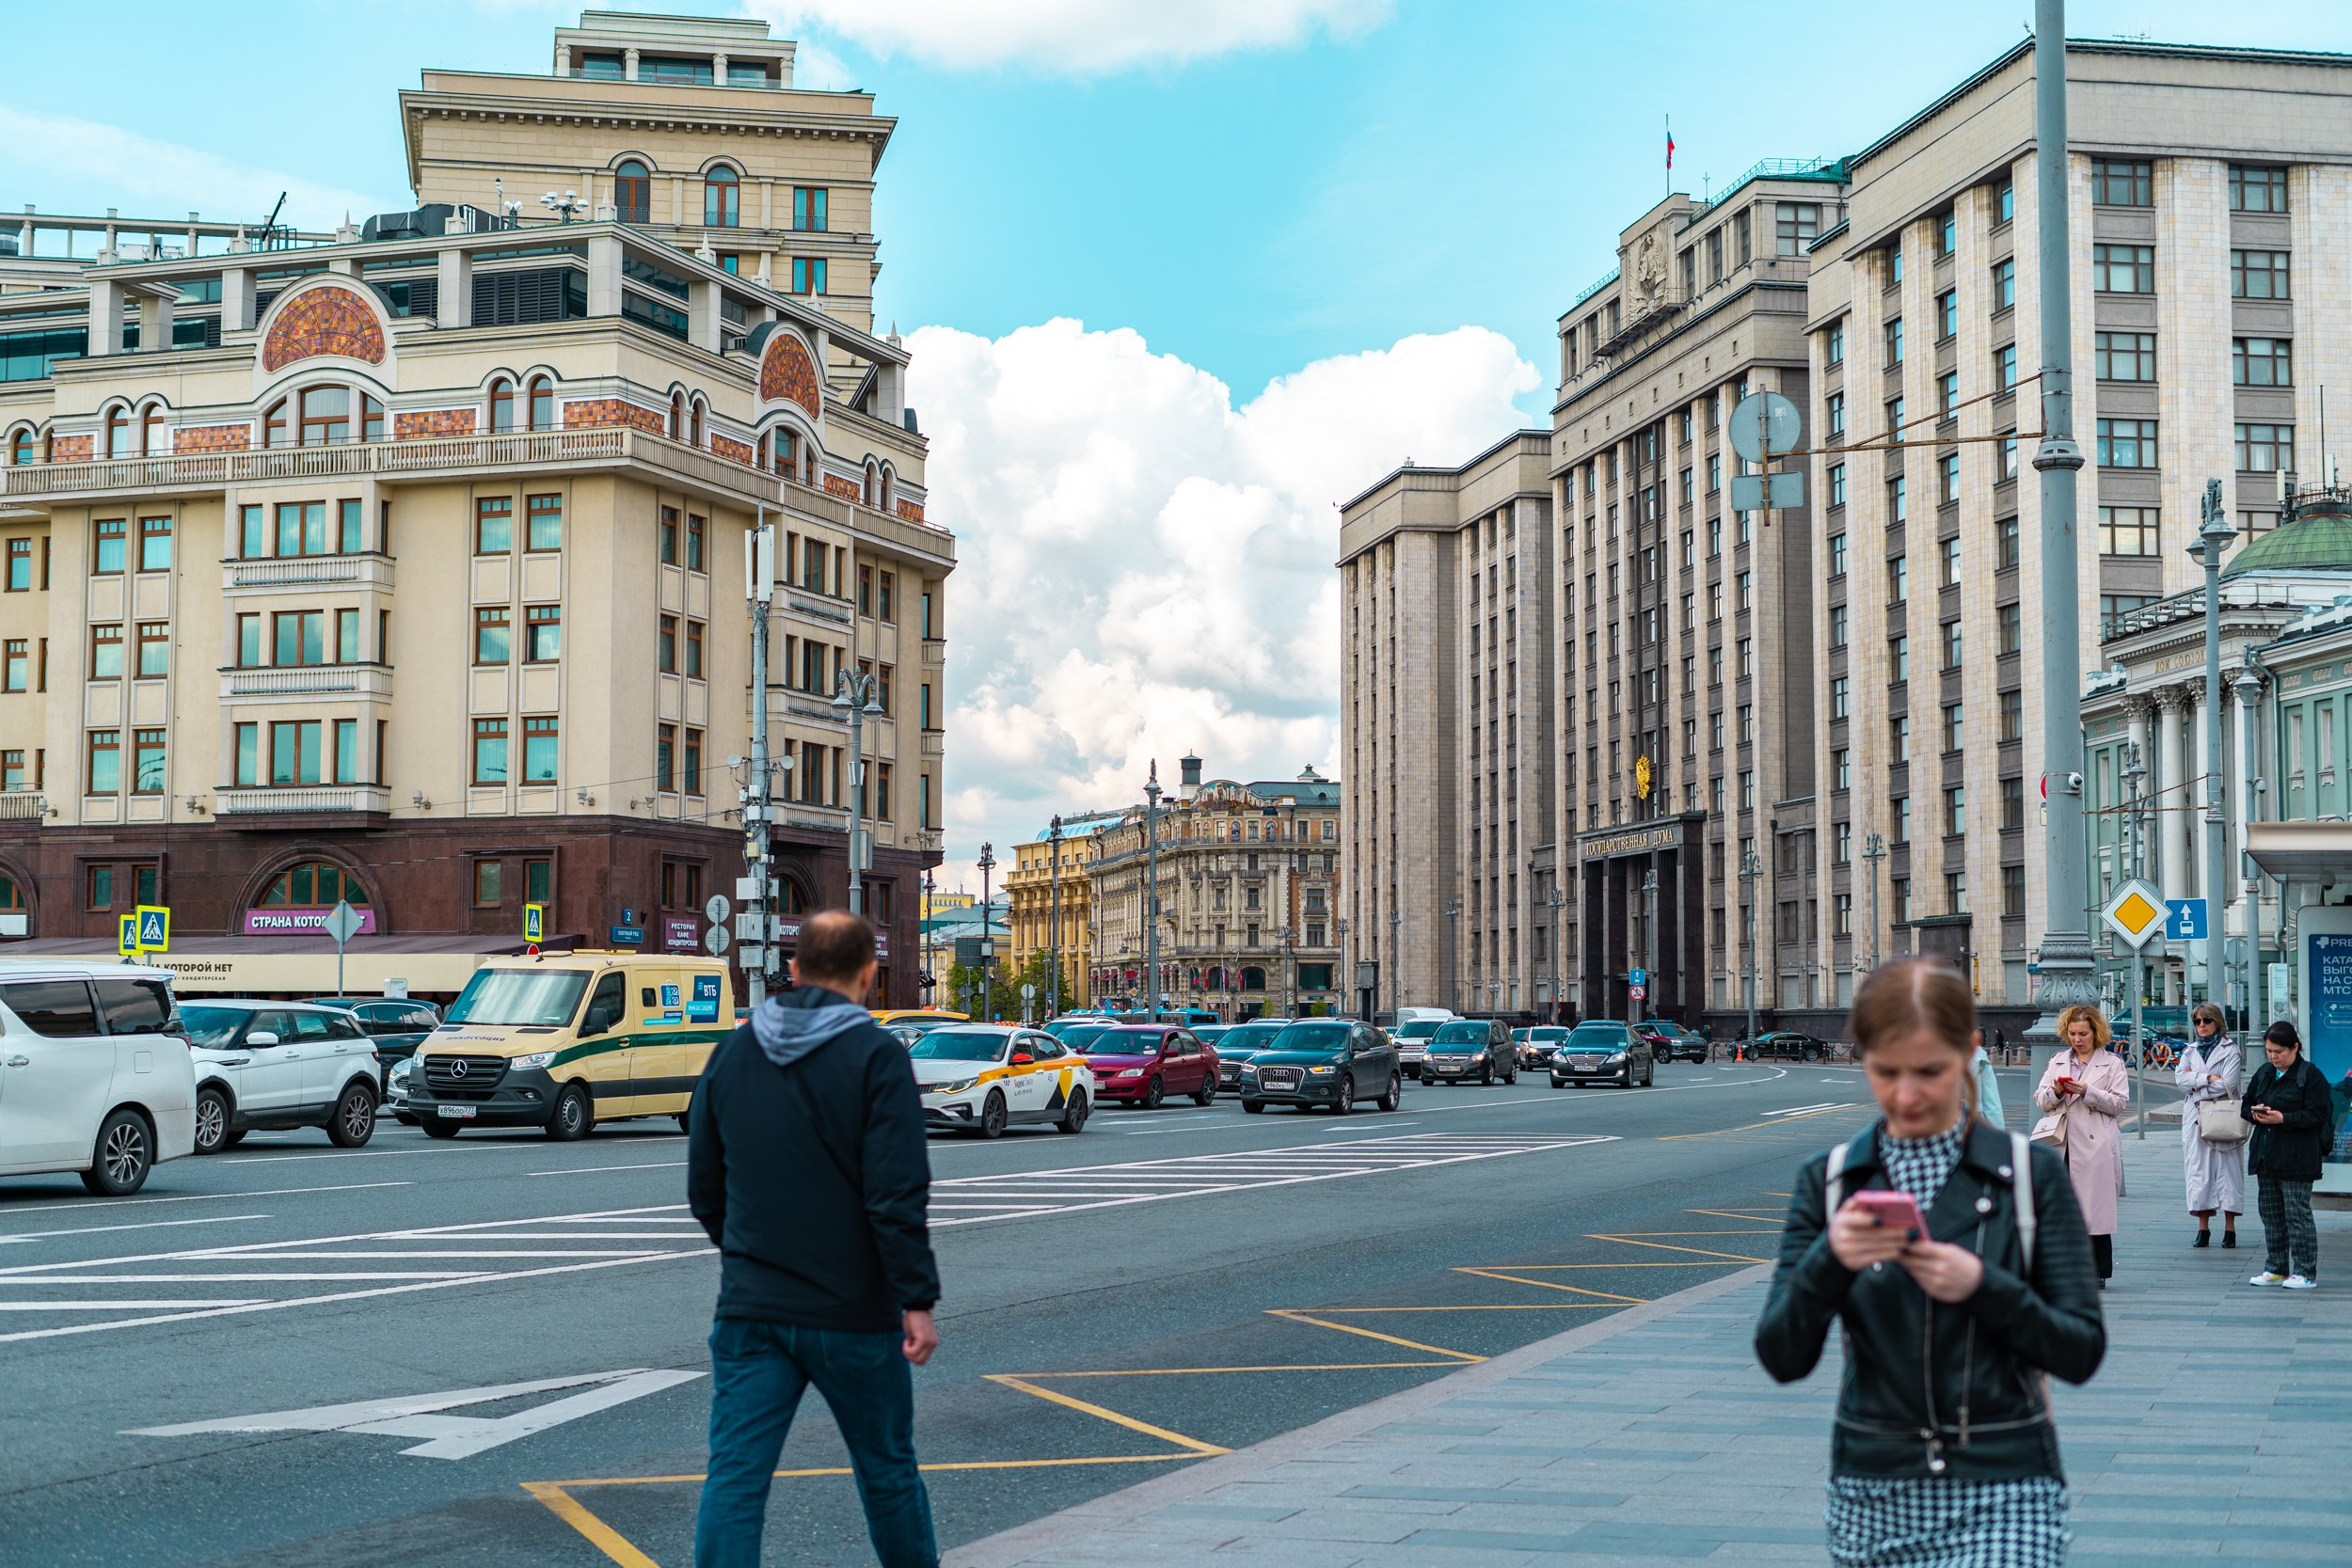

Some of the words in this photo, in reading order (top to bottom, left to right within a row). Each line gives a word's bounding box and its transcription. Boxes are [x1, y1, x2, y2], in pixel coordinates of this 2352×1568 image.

[2155, 658, 2169, 673] ДОМ
[2174, 649, 2204, 668] СОЮЗОВ
[1586, 832, 1647, 856] ГОСУДАРСТВЕННАЯ
[1653, 829, 1673, 847] ДУМА
[251, 916, 292, 927] СТРАНА
[294, 915, 326, 927] КОТО
[627, 911, 631, 922] 2
[779, 925, 800, 936] КОТОРО
[215, 963, 233, 973] НЕТ
[2323, 975, 2342, 985] НА
[703, 985, 717, 997] ВТБ
[2324, 986, 2351, 995] МТС
